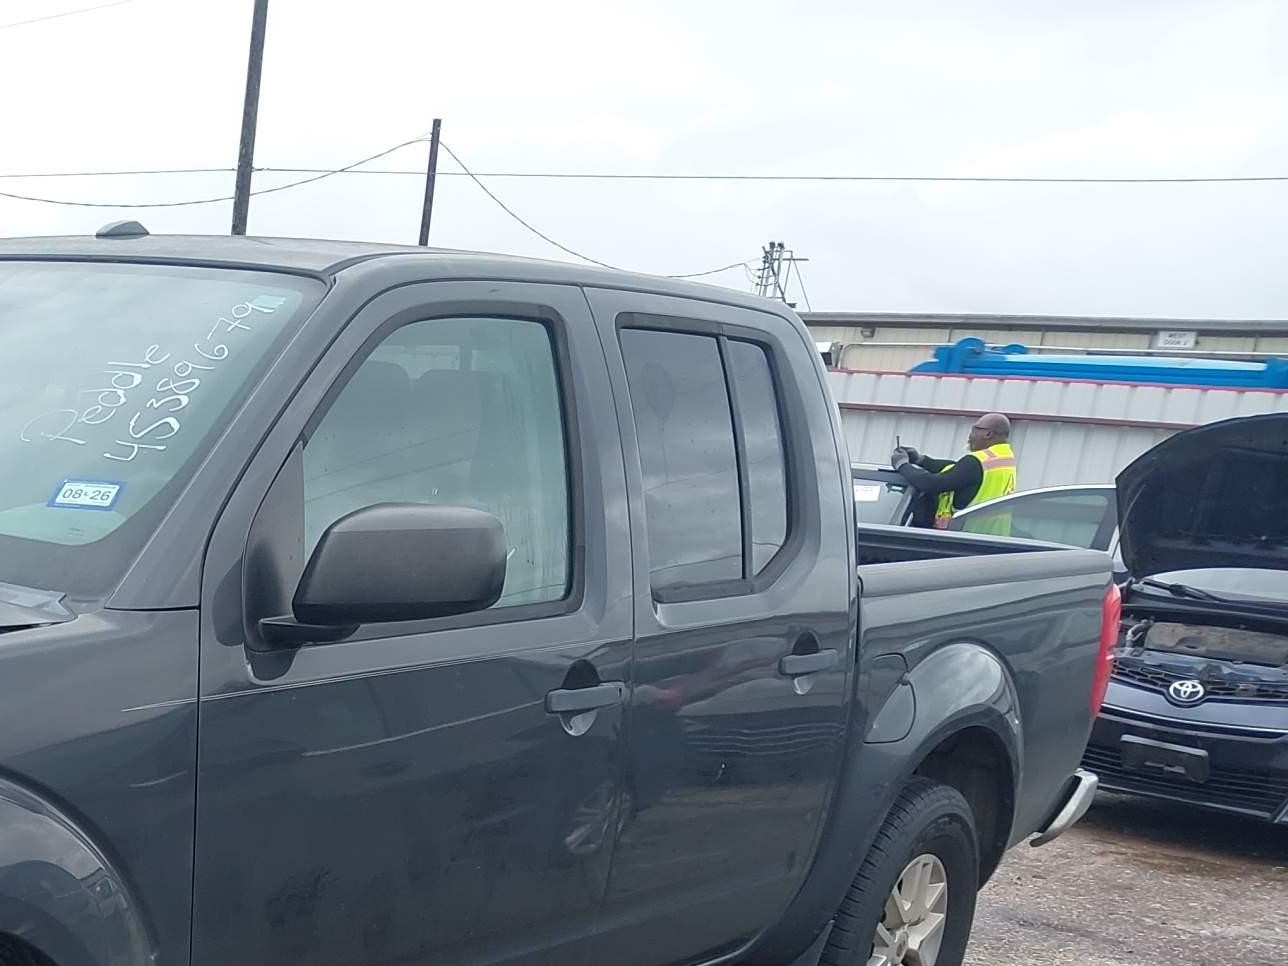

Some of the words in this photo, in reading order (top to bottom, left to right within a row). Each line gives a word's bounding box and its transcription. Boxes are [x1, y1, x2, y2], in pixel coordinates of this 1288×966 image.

[20, 344, 170, 445] Peddle
[103, 300, 275, 462] 45389679
[61, 488, 84, 500] 08
[89, 489, 113, 502] 26
